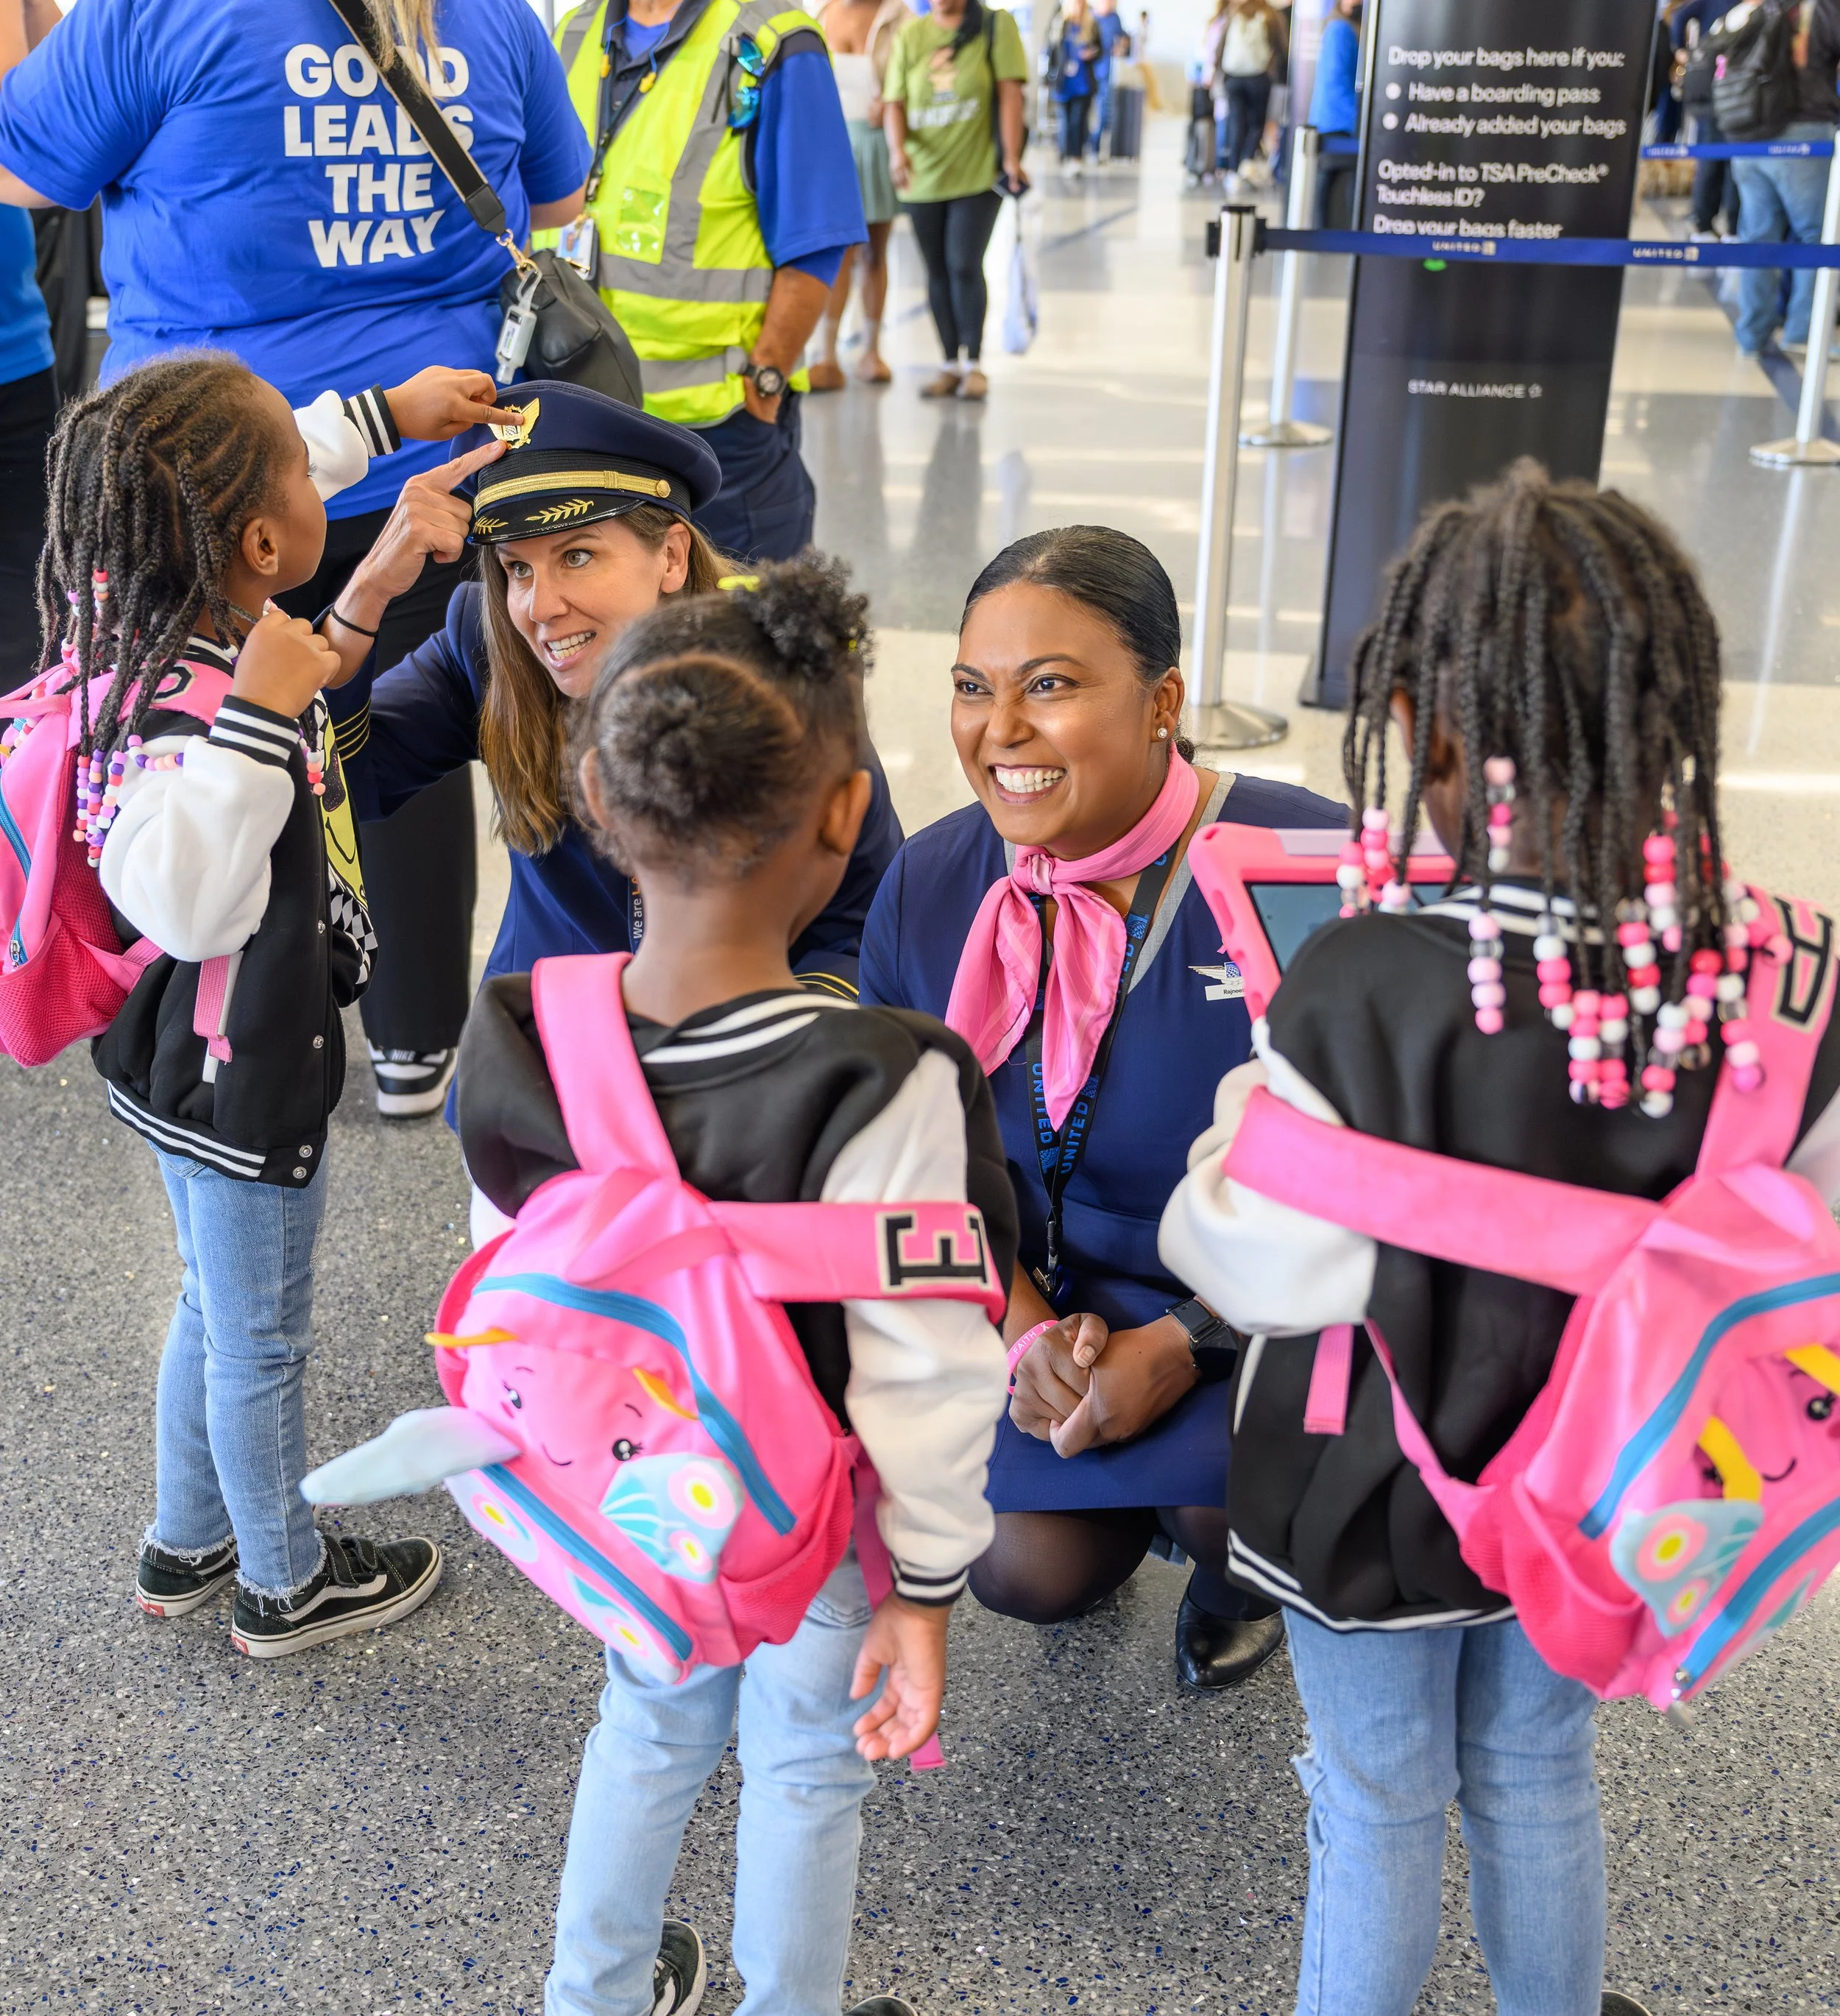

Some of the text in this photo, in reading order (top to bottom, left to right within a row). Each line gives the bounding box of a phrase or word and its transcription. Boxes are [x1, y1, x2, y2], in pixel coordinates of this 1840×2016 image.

[1388, 46, 1625, 71] Drop your bags here if you:
[1409, 81, 1602, 107] Have a boarding pass
[1404, 112, 1627, 139] Already added your bags
[1378, 159, 1457, 184] Opted-in
[1457, 164, 1479, 183] to
[1479, 162, 1516, 183] TSA
[325, 163, 434, 213] THE
[1376, 184, 1486, 208] Touchless ID?
[308, 209, 445, 268] WAY
[1507, 218, 1564, 239] faster
[1432, 239, 1482, 252] UNITED
[1632, 247, 1683, 259] UNITED
[1407, 378, 1527, 399] STAR ALLIANCE
[634, 898, 643, 918] are
[633, 919, 643, 939] We
[392, 1049, 416, 1061] NIKE
[1061, 1102, 1089, 1174] UNITED
[877, 1209, 992, 1293] E
[1013, 1331, 1036, 1354] FAITH
